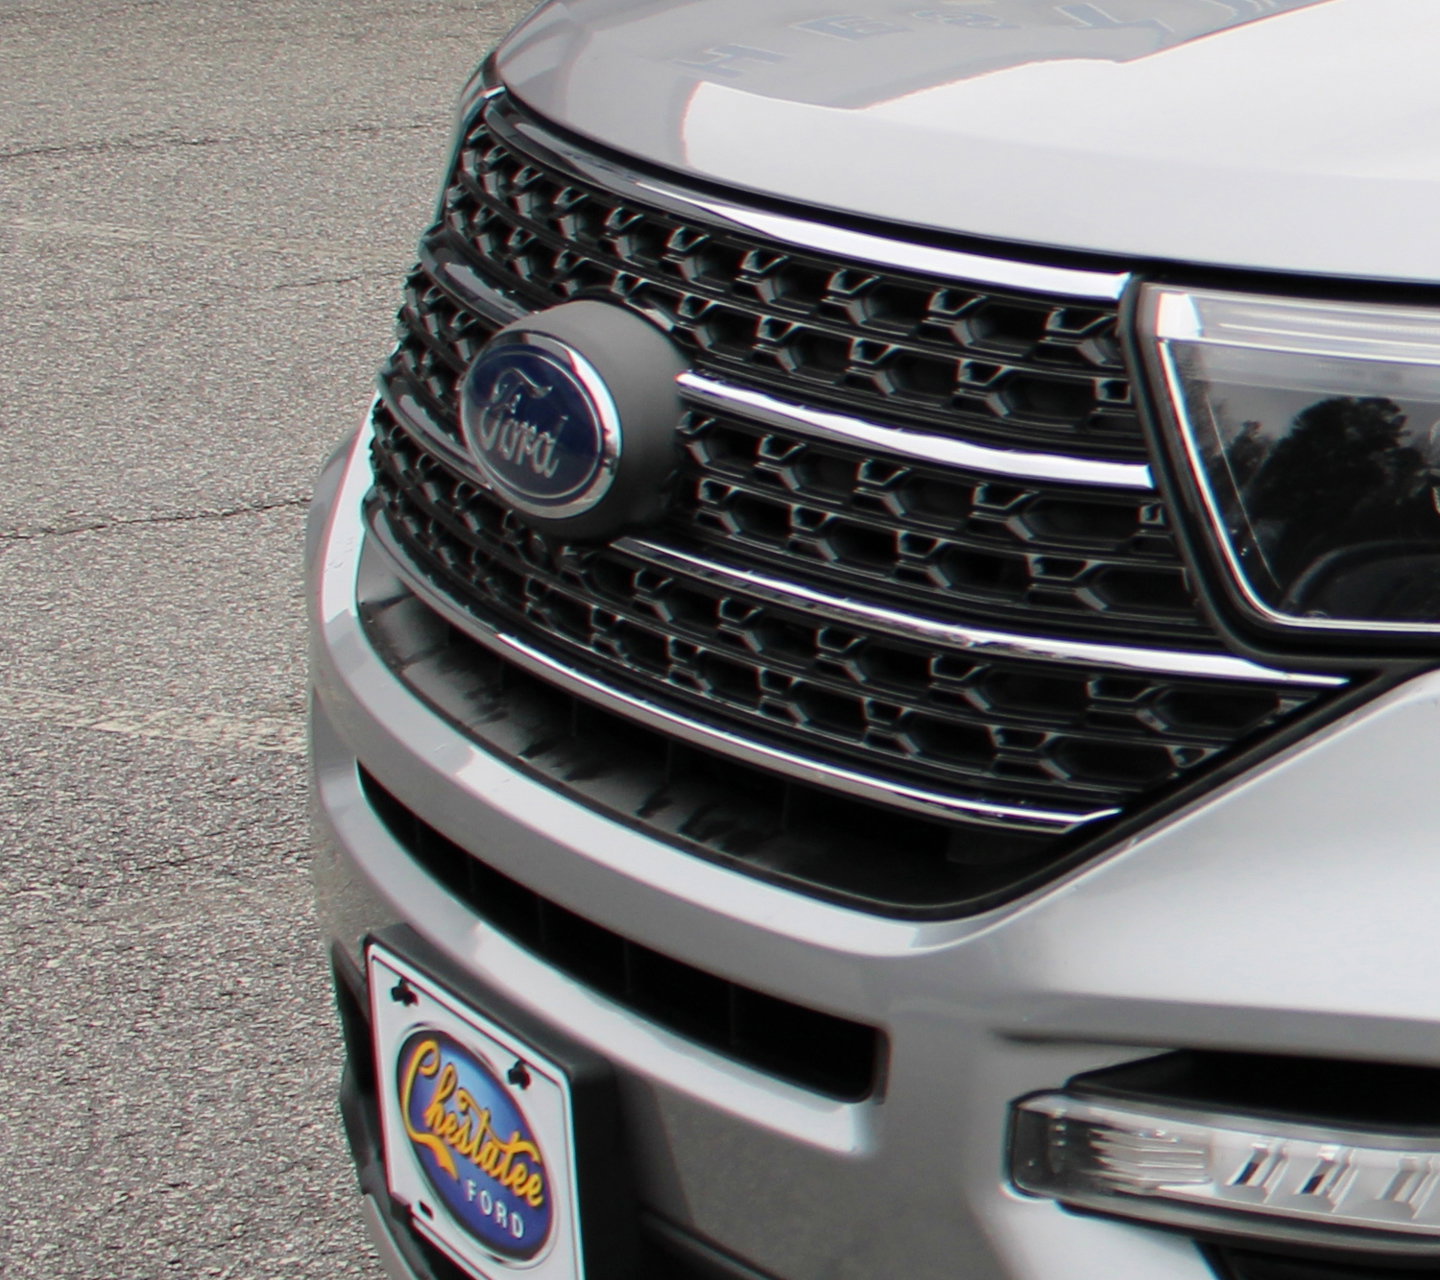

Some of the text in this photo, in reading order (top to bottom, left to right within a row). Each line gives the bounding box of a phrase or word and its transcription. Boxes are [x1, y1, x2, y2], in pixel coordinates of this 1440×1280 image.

[479, 367, 570, 480] Ford
[400, 1038, 545, 1209] Chestatee
[464, 1178, 525, 1240] FORD
